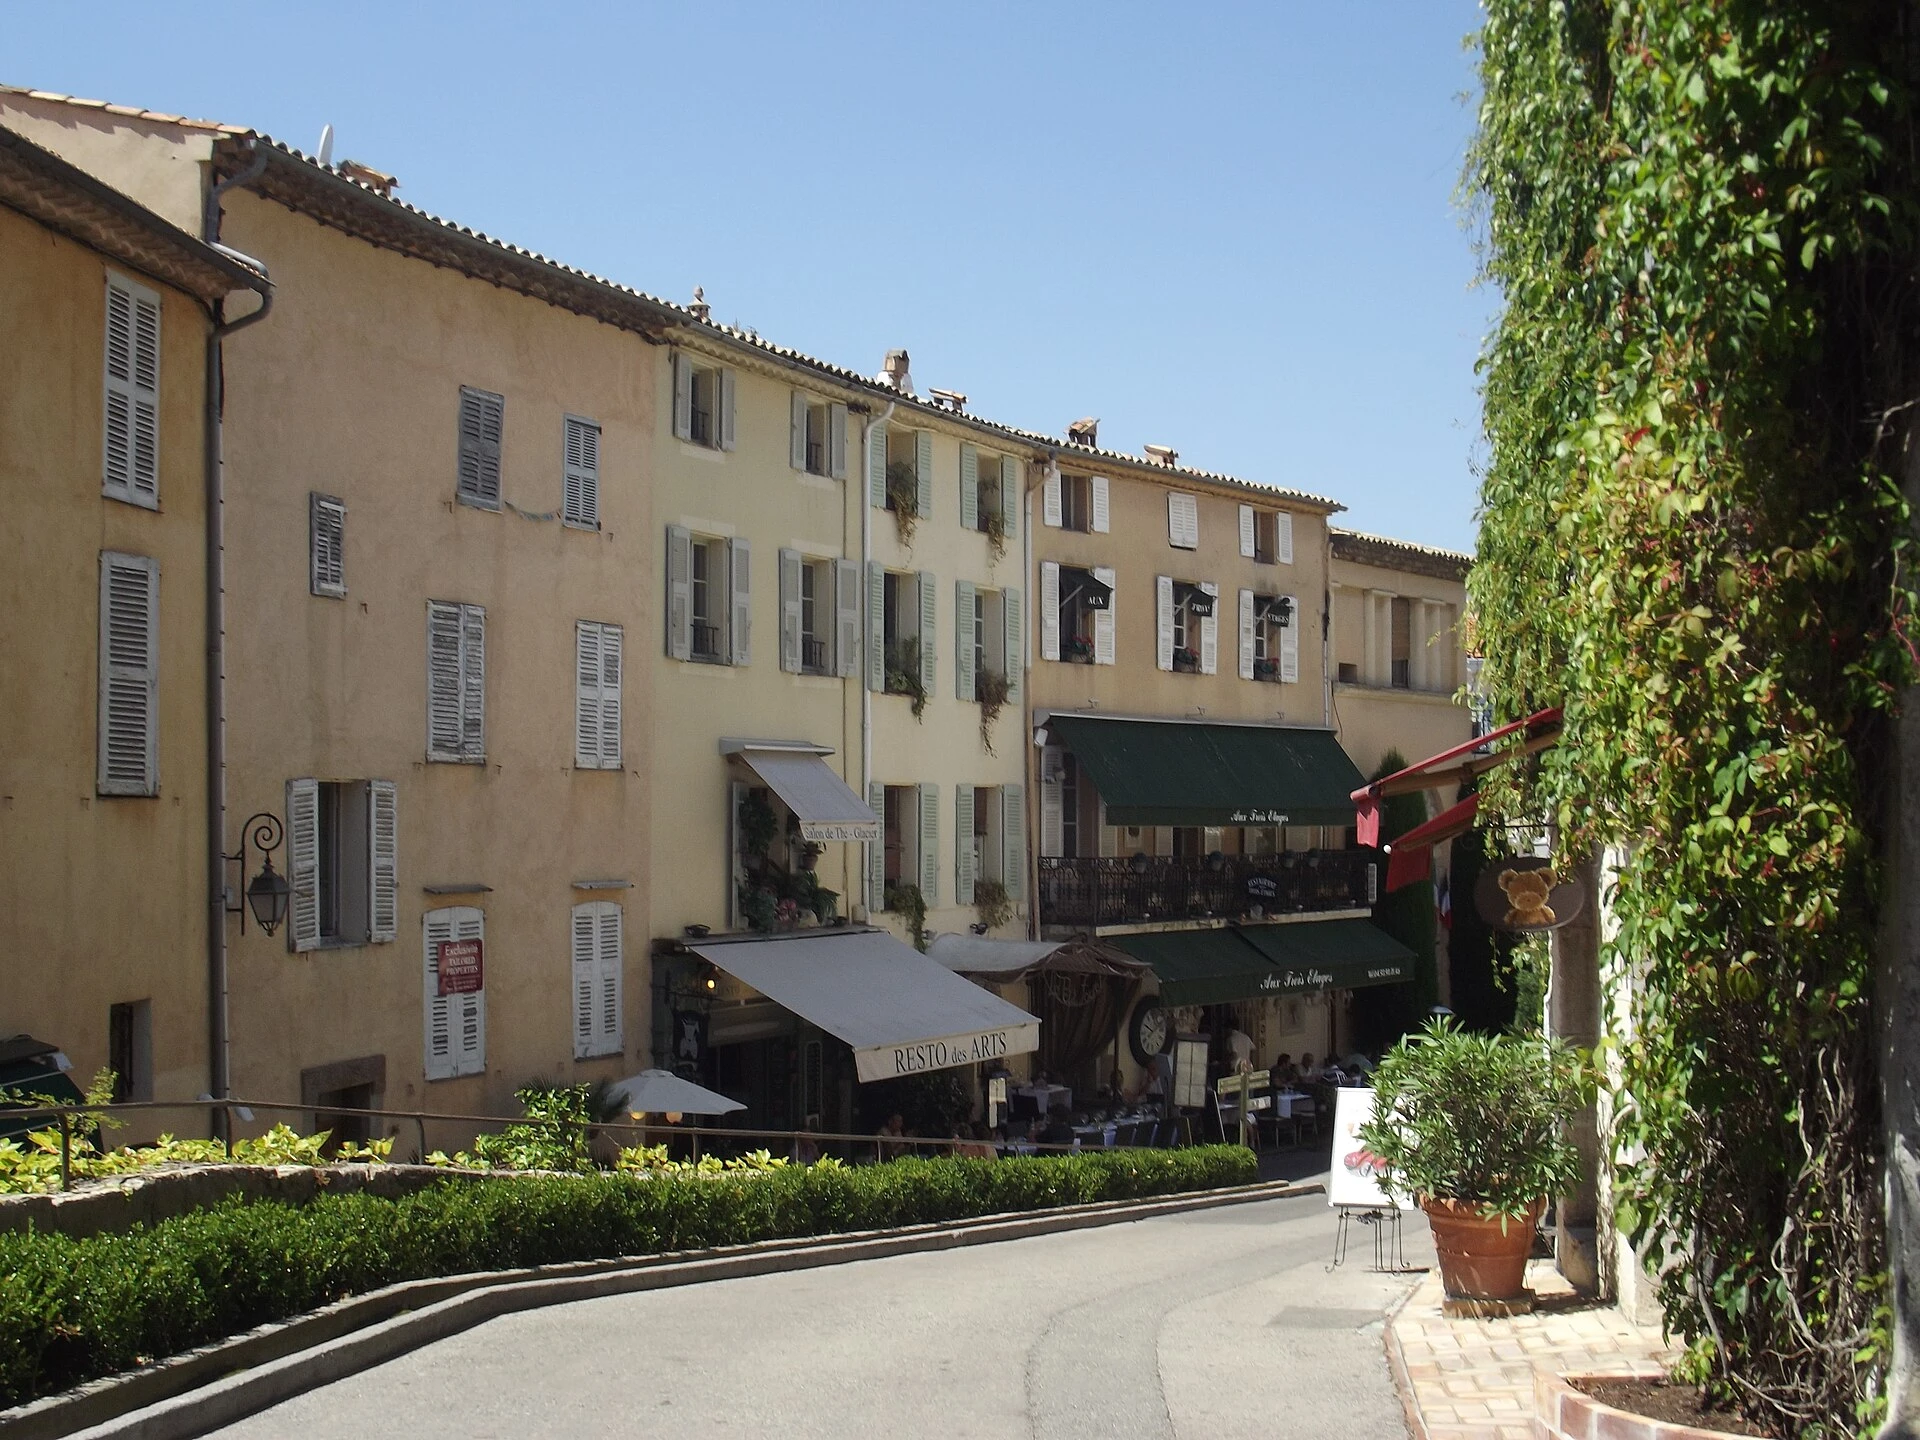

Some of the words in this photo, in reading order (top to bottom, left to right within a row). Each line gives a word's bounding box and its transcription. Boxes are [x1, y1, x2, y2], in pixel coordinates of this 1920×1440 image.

[1088, 596, 1104, 605] AUX
[1230, 809, 1247, 821] Aux
[805, 827, 824, 839] Salon
[825, 828, 834, 839] de
[854, 827, 878, 839] Glacier
[1260, 973, 1280, 989] Aux
[894, 1041, 947, 1074] RESTO
[951, 1046, 968, 1064] des
[971, 1031, 1007, 1061] ARTS
